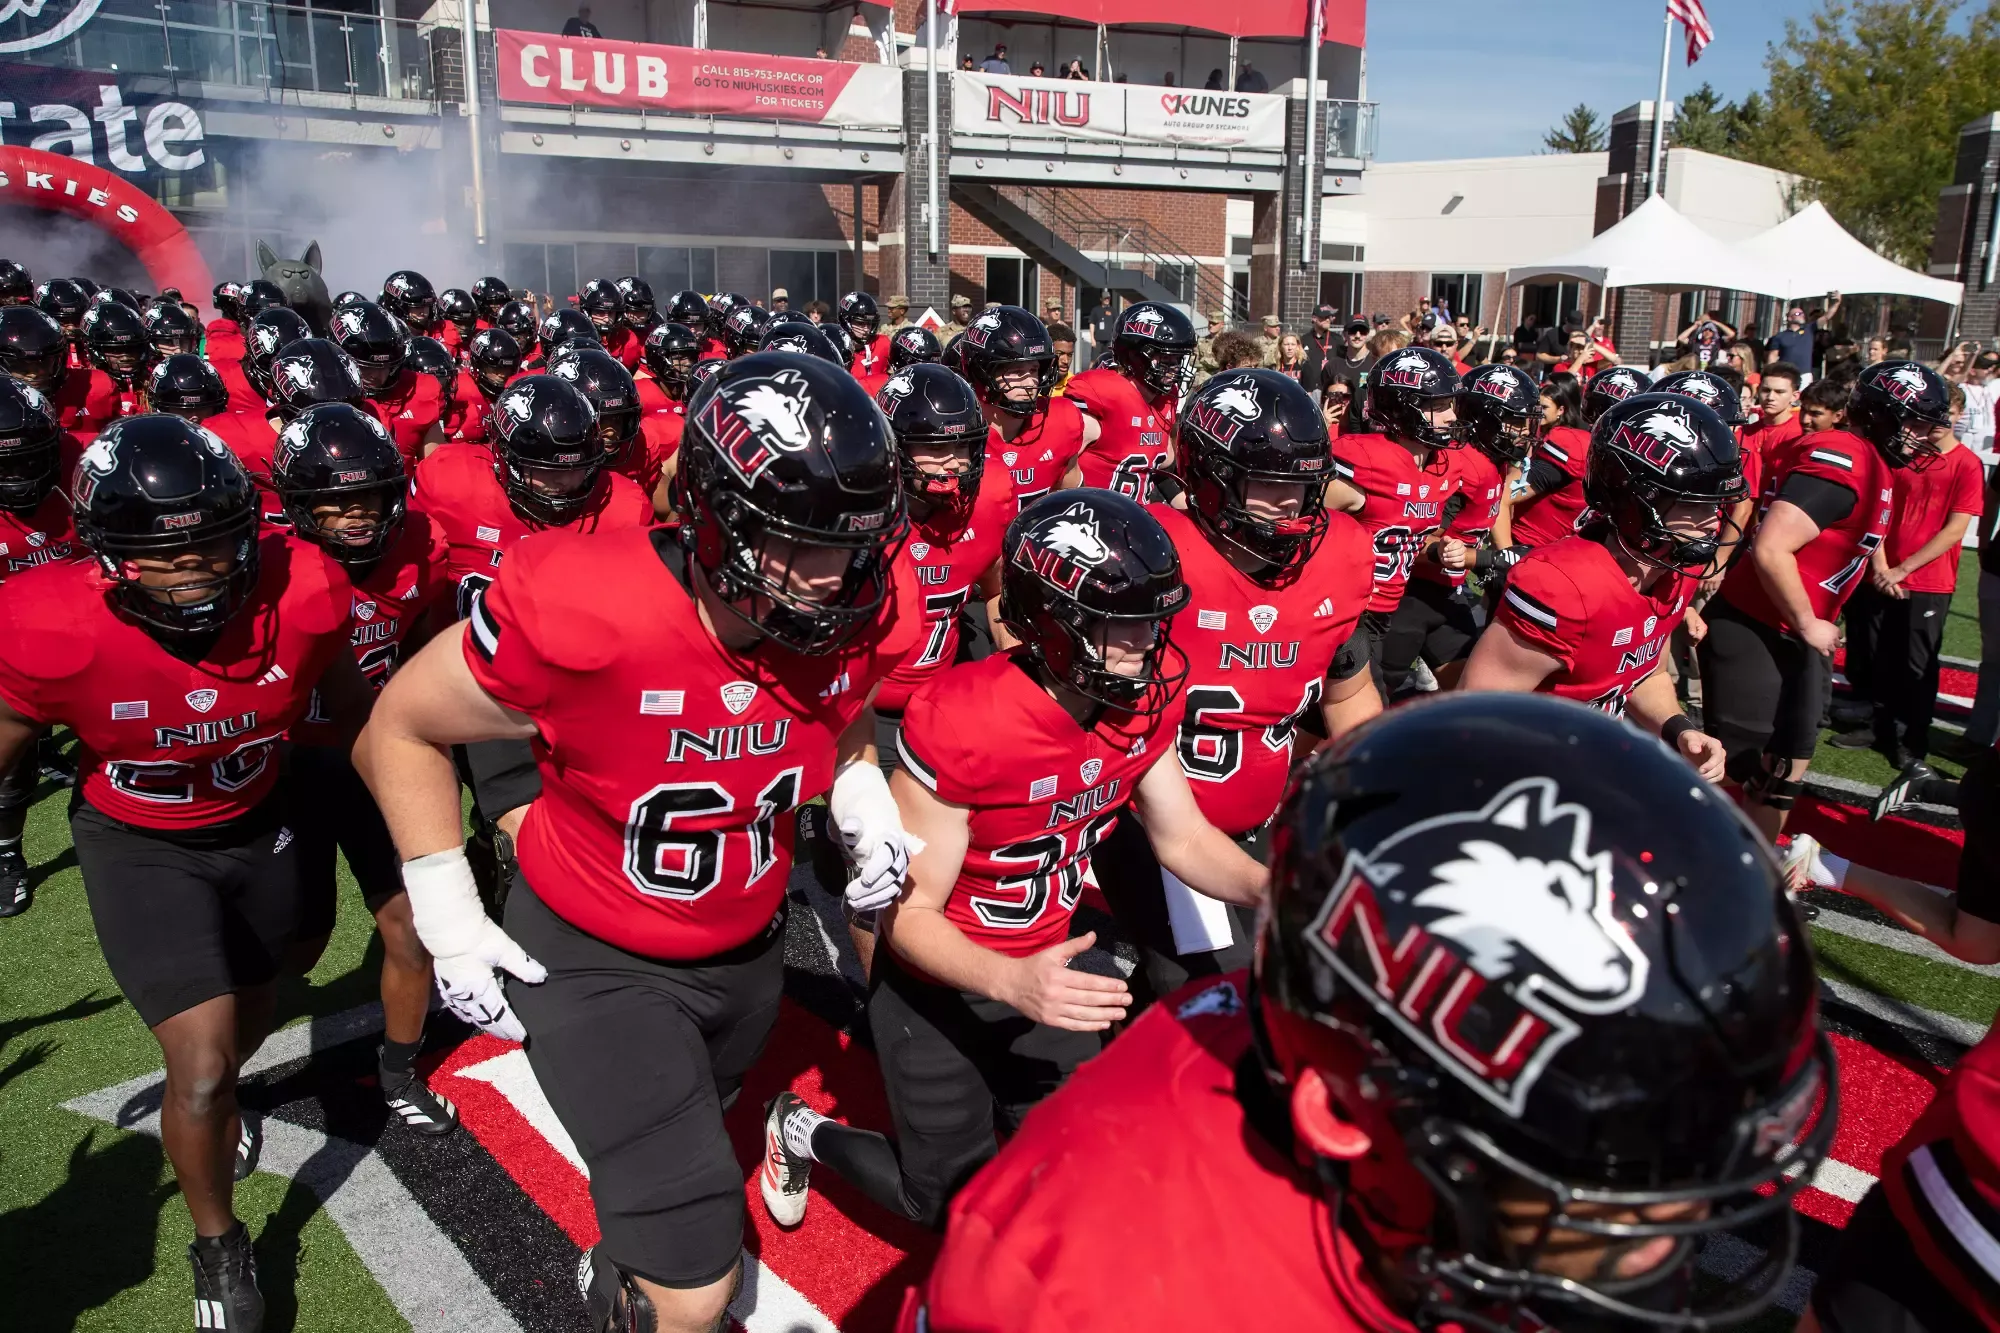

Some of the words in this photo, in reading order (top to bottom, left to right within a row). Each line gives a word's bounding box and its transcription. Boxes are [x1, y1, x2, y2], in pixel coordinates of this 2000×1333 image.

[520, 44, 669, 99] CLUB
[702, 64, 730, 76] CALL
[733, 67, 804, 82] 815-753-PACK
[807, 74, 823, 84] OR
[694, 77, 711, 87] GO
[714, 78, 729, 89] TO
[732, 80, 824, 96] NIUHUSKIES.COM
[755, 95, 777, 106] FOR
[780, 97, 824, 109] TICKETS
[985, 85, 1091, 128] NIU
[1175, 94, 1251, 118] KUNES
[1125, 321, 1156, 337] NIU
[898, 336, 919, 353] NIU
[1029, 344, 1045, 354] NIU
[1382, 370, 1420, 388] NIU
[1874, 375, 1912, 400] NIU
[1473, 380, 1512, 400] NIU
[1596, 382, 1628, 399] NIU
[604, 398, 623, 408] NIU
[700, 394, 770, 474] NIU
[944, 423, 966, 435] NIU
[1188, 403, 1238, 444] NIU
[1140, 432, 1164, 446] NIU
[1612, 424, 1676, 468] NIU
[558, 453, 580, 463] NIU
[1300, 458, 1323, 471] NIU
[339, 470, 367, 484] NIU
[164, 511, 201, 530] NIU
[1403, 501, 1439, 519] NIU
[849, 512, 885, 532] NIU
[8, 541, 72, 573] NIU
[1017, 539, 1081, 592] NIU
[915, 565, 951, 586] IU
[1162, 586, 1184, 608] NIU
[913, 583, 970, 667] 7
[1217, 641, 1301, 670] NIU
[1616, 632, 1666, 675] NIU
[154, 709, 259, 749] NIU
[665, 717, 792, 764] NIU
[1045, 777, 1121, 830] NIU
[621, 765, 804, 900] 61
[1320, 874, 1552, 1080] NIU
